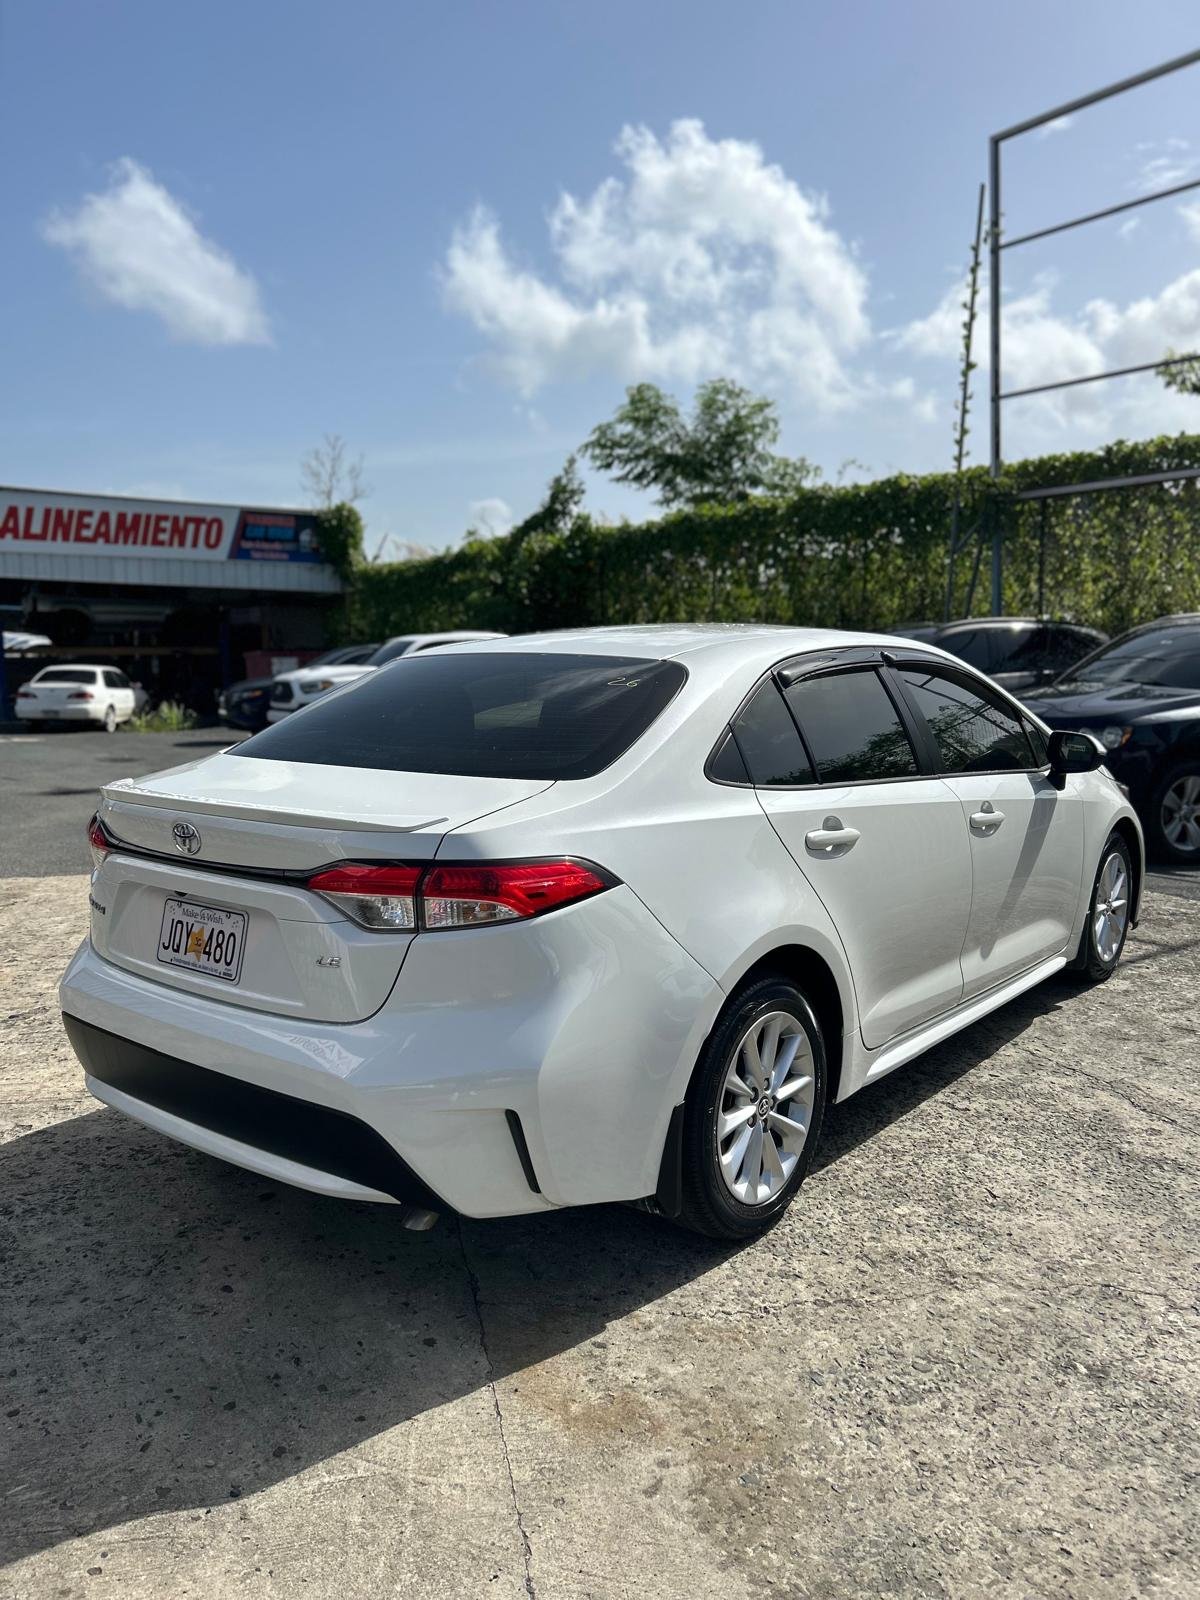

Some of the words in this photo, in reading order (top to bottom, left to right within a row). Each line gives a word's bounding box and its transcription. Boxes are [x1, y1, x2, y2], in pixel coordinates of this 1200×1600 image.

[0, 505, 224, 550] ALINEAMIENTO
[162, 918, 194, 956] JQY
[202, 927, 237, 967] 480
